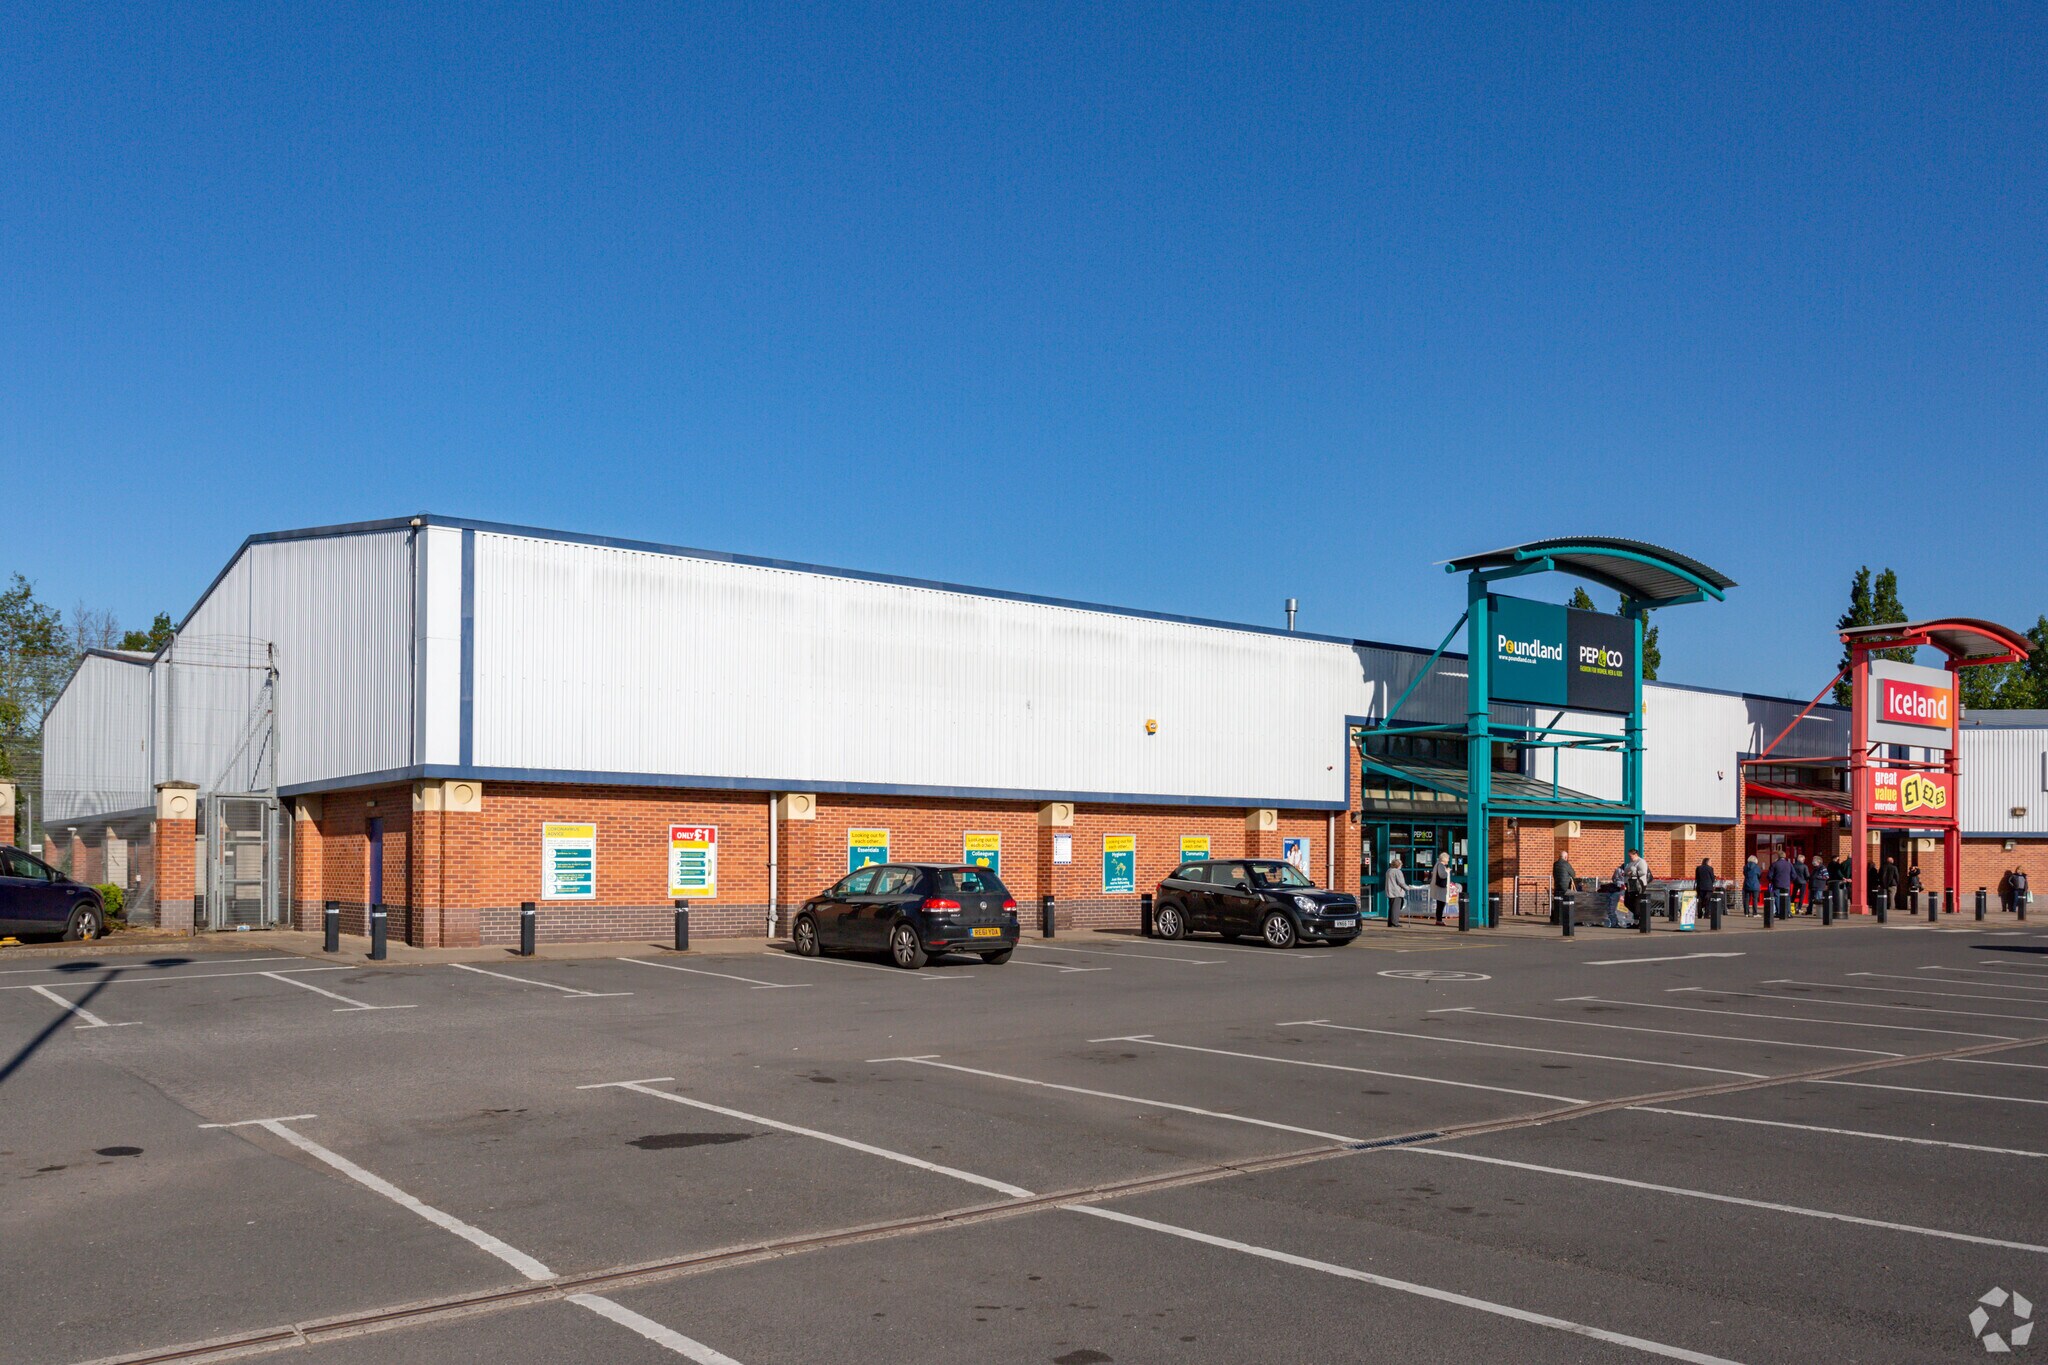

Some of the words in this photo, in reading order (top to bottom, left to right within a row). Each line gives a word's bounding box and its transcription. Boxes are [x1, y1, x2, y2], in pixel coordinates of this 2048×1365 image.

[1498, 634, 1562, 661] Poundland
[1498, 655, 1537, 665] www.poundland.co.uk
[1890, 687, 1947, 720] Iceland
[1875, 771, 1897, 786] great
[1875, 787, 1897, 801] value
[1905, 780, 1919, 806] £1
[1922, 785, 1934, 803] £2
[1936, 791, 1945, 805] £3
[1875, 802, 1897, 812] everyday!
[676, 832, 694, 840] ONLY
[694, 829, 709, 842] £1
